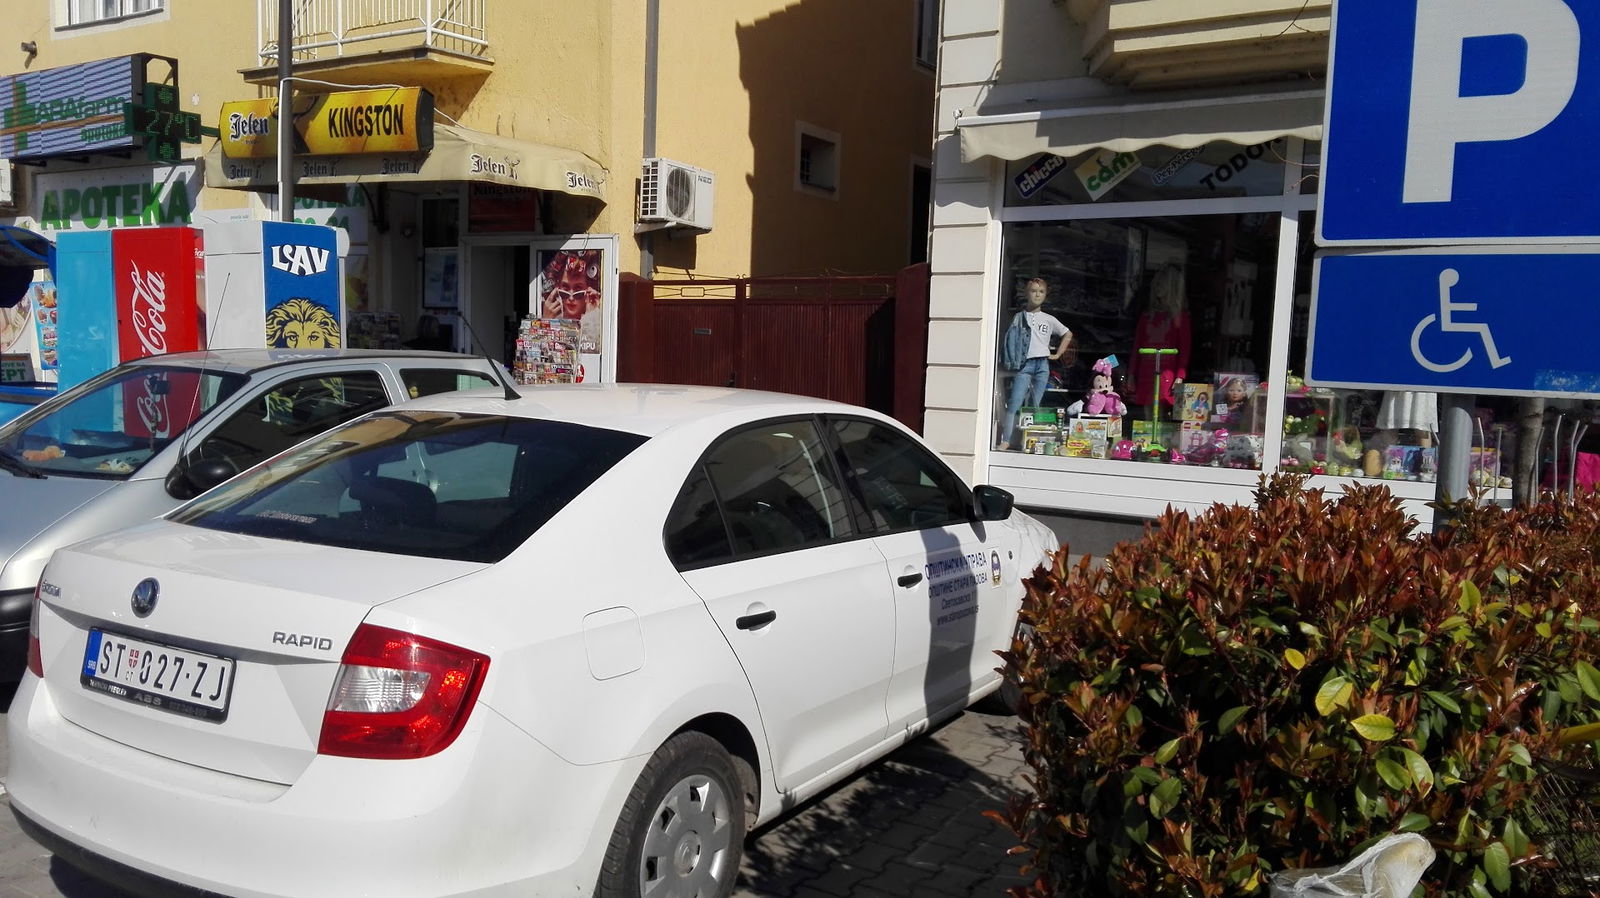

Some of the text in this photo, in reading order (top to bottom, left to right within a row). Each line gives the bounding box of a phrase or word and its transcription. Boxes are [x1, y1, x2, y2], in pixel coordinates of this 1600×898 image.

[1402, 0, 1581, 203] P
[229, 111, 270, 142] Jelen
[328, 103, 405, 138] KINGSTON
[229, 164, 253, 180] Jelen
[303, 161, 328, 176] Jelen
[381, 158, 409, 175] Jelen
[471, 154, 506, 174] Jelen
[1019, 153, 1064, 192] chicco
[41, 179, 193, 230] APOTEKA
[271, 244, 330, 276] LAV
[131, 259, 167, 354] Cola
[272, 631, 333, 651] RAPID
[99, 640, 126, 679] ST
[133, 692, 162, 706] ABS
